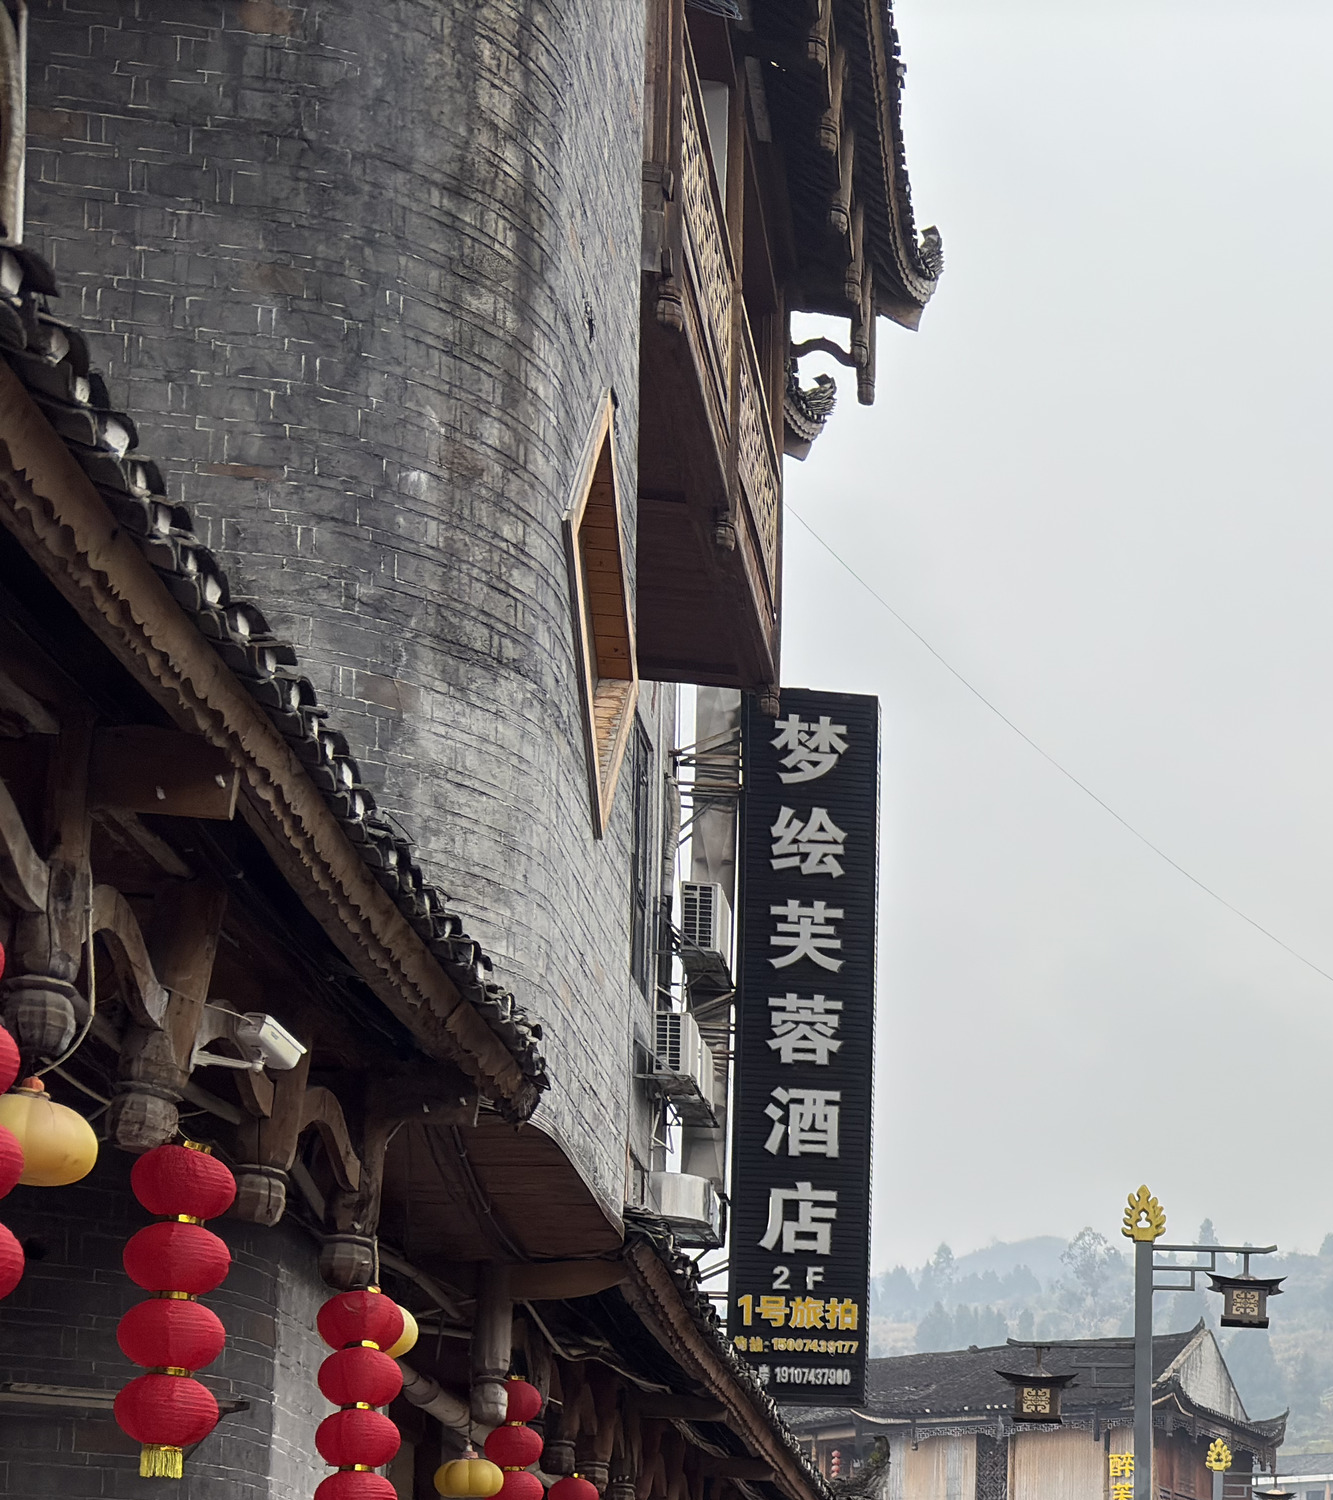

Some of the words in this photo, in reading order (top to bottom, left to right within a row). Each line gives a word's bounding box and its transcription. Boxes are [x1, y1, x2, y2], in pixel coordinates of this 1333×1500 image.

[759, 713, 849, 1257] 梦绘芙蓉酒店
[737, 1294, 859, 1331] 1号旅拍
